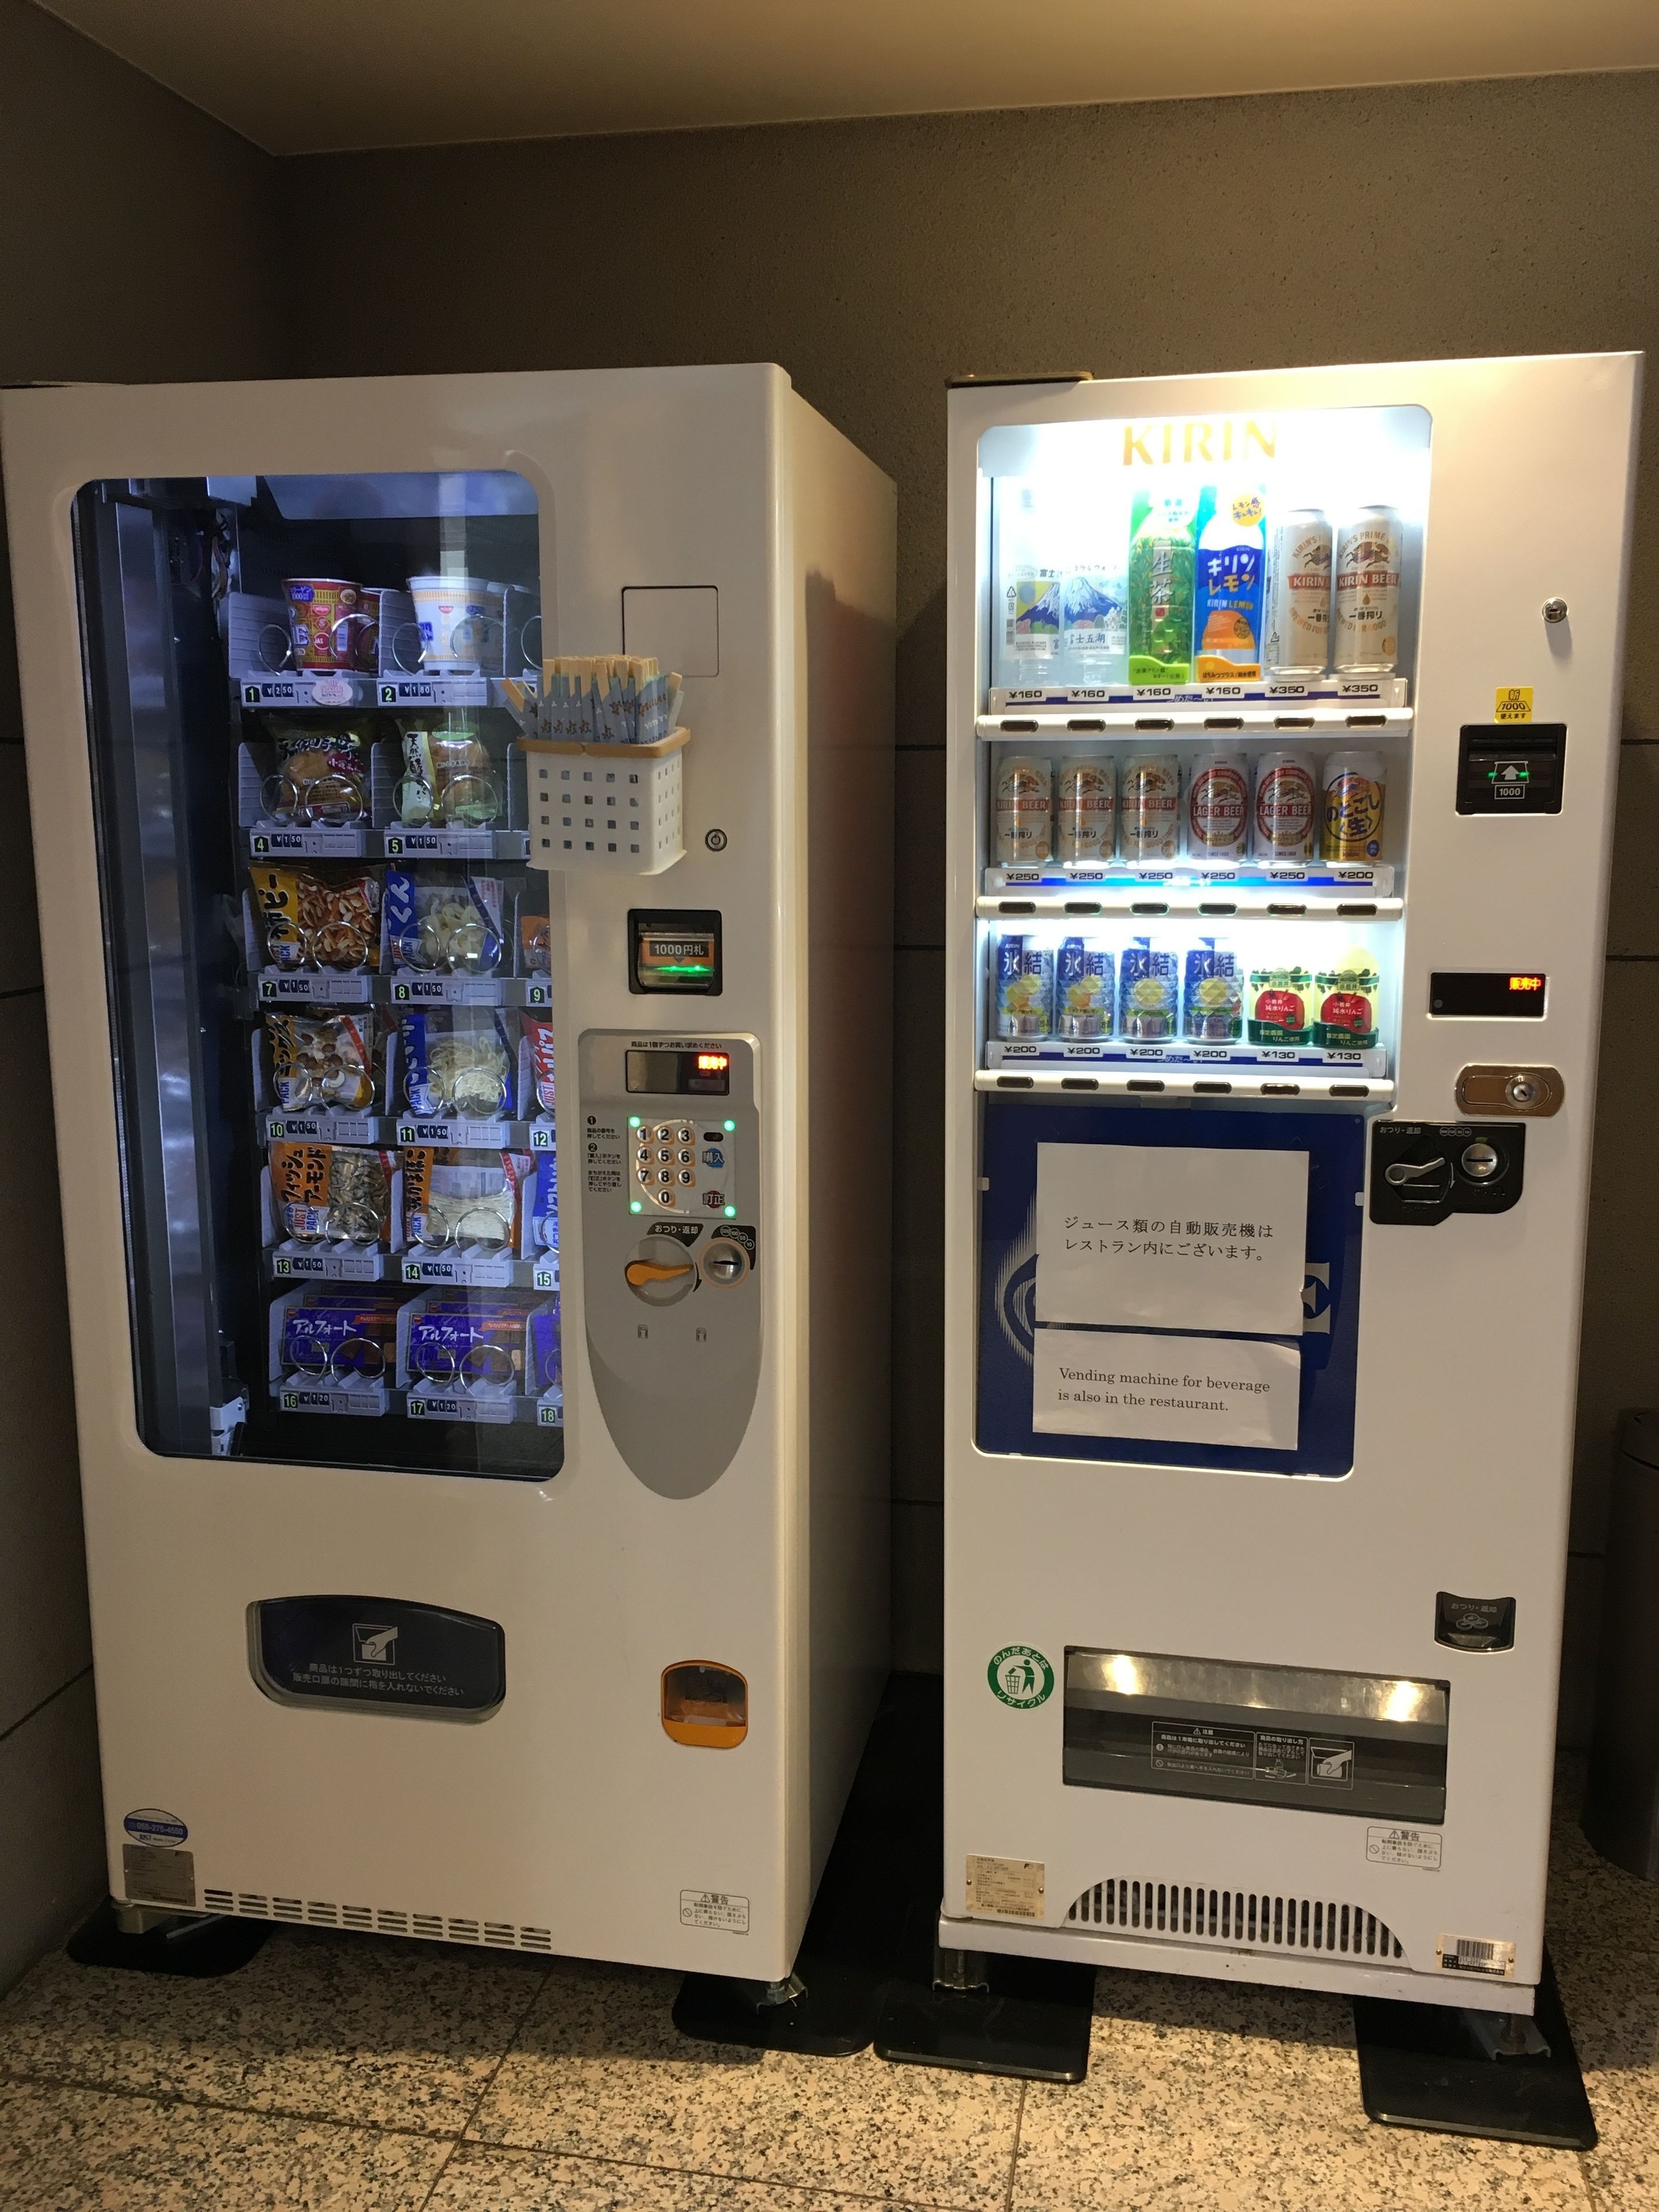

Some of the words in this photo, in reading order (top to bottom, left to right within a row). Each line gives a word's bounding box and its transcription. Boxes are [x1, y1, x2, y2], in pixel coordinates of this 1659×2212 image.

[1123, 421, 1276, 465] KIRIN
[1359, 530, 1385, 540] PRIME
[1207, 553, 1255, 577] キリン
[1150, 551, 1173, 605] 生茶
[1339, 574, 1368, 587] KIRIN
[1372, 573, 1397, 585] BEER
[1209, 574, 1255, 597] レモン
[1207, 599, 1226, 609] KIRIN
[1349, 611, 1384, 622] 一番搾り
[248, 688, 255, 702] 1
[385, 688, 392, 702] 2
[1009, 690, 1043, 699] ¥160
[1071, 690, 1105, 699] ¥160
[1136, 688, 1172, 696] ¥160
[1205, 686, 1241, 695] ¥160
[1269, 685, 1305, 694] ¥350
[1342, 684, 1379, 694] ¥350
[1508, 688, 1521, 702] 新
[1501, 702, 1527, 711] 1000
[1498, 787, 1521, 797] 1000
[1022, 800, 1047, 810] BEER
[1086, 800, 1111, 809] BEER
[1148, 799, 1173, 809] BEER
[1193, 805, 1221, 817] LAGER
[1224, 805, 1245, 816] BEER
[1259, 805, 1289, 816] LAGER
[1291, 805, 1312, 816] BEER
[257, 839, 264, 851] 4
[392, 840, 399, 853] 5
[1007, 873, 1040, 881] ¥250
[1070, 872, 1104, 881] ¥250
[1138, 872, 1173, 880] ¥250
[1270, 872, 1306, 880] ¥250
[1338, 872, 1374, 880] ¥200
[654, 944, 704, 956] 1000円札
[1003, 952, 1042, 975] 氷結
[1065, 952, 1104, 976] 氷結
[1130, 952, 1171, 976] 氷結
[1194, 953, 1235, 978] 氷結
[266, 983, 273, 995] 7
[1509, 977, 1541, 991] 販売中
[398, 986, 406, 999] 8
[533, 988, 541, 1001] 9
[1067, 1047, 1100, 1055] ¥200
[1130, 1048, 1164, 1056] ¥200
[1193, 1050, 1228, 1058] ¥200
[1262, 1051, 1296, 1059] ¥130
[1327, 1052, 1361, 1060] ¥130
[279, 1081, 290, 1104] PACK
[410, 1088, 422, 1112] PACK
[271, 1124, 283, 1137] 10
[401, 1129, 413, 1141] 11
[641, 1129, 647, 1141] 1
[662, 1129, 669, 1141] 2
[681, 1130, 690, 1142] 3
[1380, 1126, 1422, 1135] おつり・返却
[534, 1134, 547, 1146] 12
[640, 1150, 648, 1161] 4
[662, 1150, 669, 1162] 5
[681, 1151, 690, 1162] 6
[702, 1150, 725, 1164] 購入
[280, 1148, 305, 1203] フィッシュ
[304, 1146, 327, 1203] アーモンド
[641, 1171, 649, 1181] 7
[662, 1171, 669, 1182] 8
[681, 1171, 690, 1183] 9
[662, 1191, 669, 1203] 0
[702, 1192, 725, 1206] 訂正
[294, 1207, 306, 1230] JUST
[654, 1225, 699, 1234] おつり・返却
[1064, 1215, 1274, 1239] ジュース類の自動販売機は
[1065, 1238, 1264, 1263] レストラン内にございます。
[277, 1262, 290, 1273] 13
[406, 1266, 418, 1278] 14
[537, 1273, 550, 1286] 15
[292, 1319, 358, 1336] アルフォート
[418, 1325, 484, 1343] アルフォート
[1059, 1368, 1115, 1385] Vending
[1119, 1372, 1179, 1387] machine
[1182, 1375, 1203, 1388] for
[1206, 1377, 1271, 1393] beverage
[285, 1395, 297, 1407] 16
[1058, 1391, 1070, 1402] is
[1074, 1391, 1101, 1404] also
[1105, 1393, 1119, 1405] in
[1123, 1393, 1146, 1406] the
[1149, 1397, 1229, 1412] restaurant.
[411, 1403, 423, 1414] 17
[542, 1411, 554, 1422] 18
[994, 1646, 1049, 1670] のんだあとは
[308, 1662, 446, 1684] 商品は1つずつ取り出してください
[997, 1690, 1046, 1708] リサイクル
[1400, 1830, 1421, 1842] 警告
[710, 1893, 729, 1906] 警告
